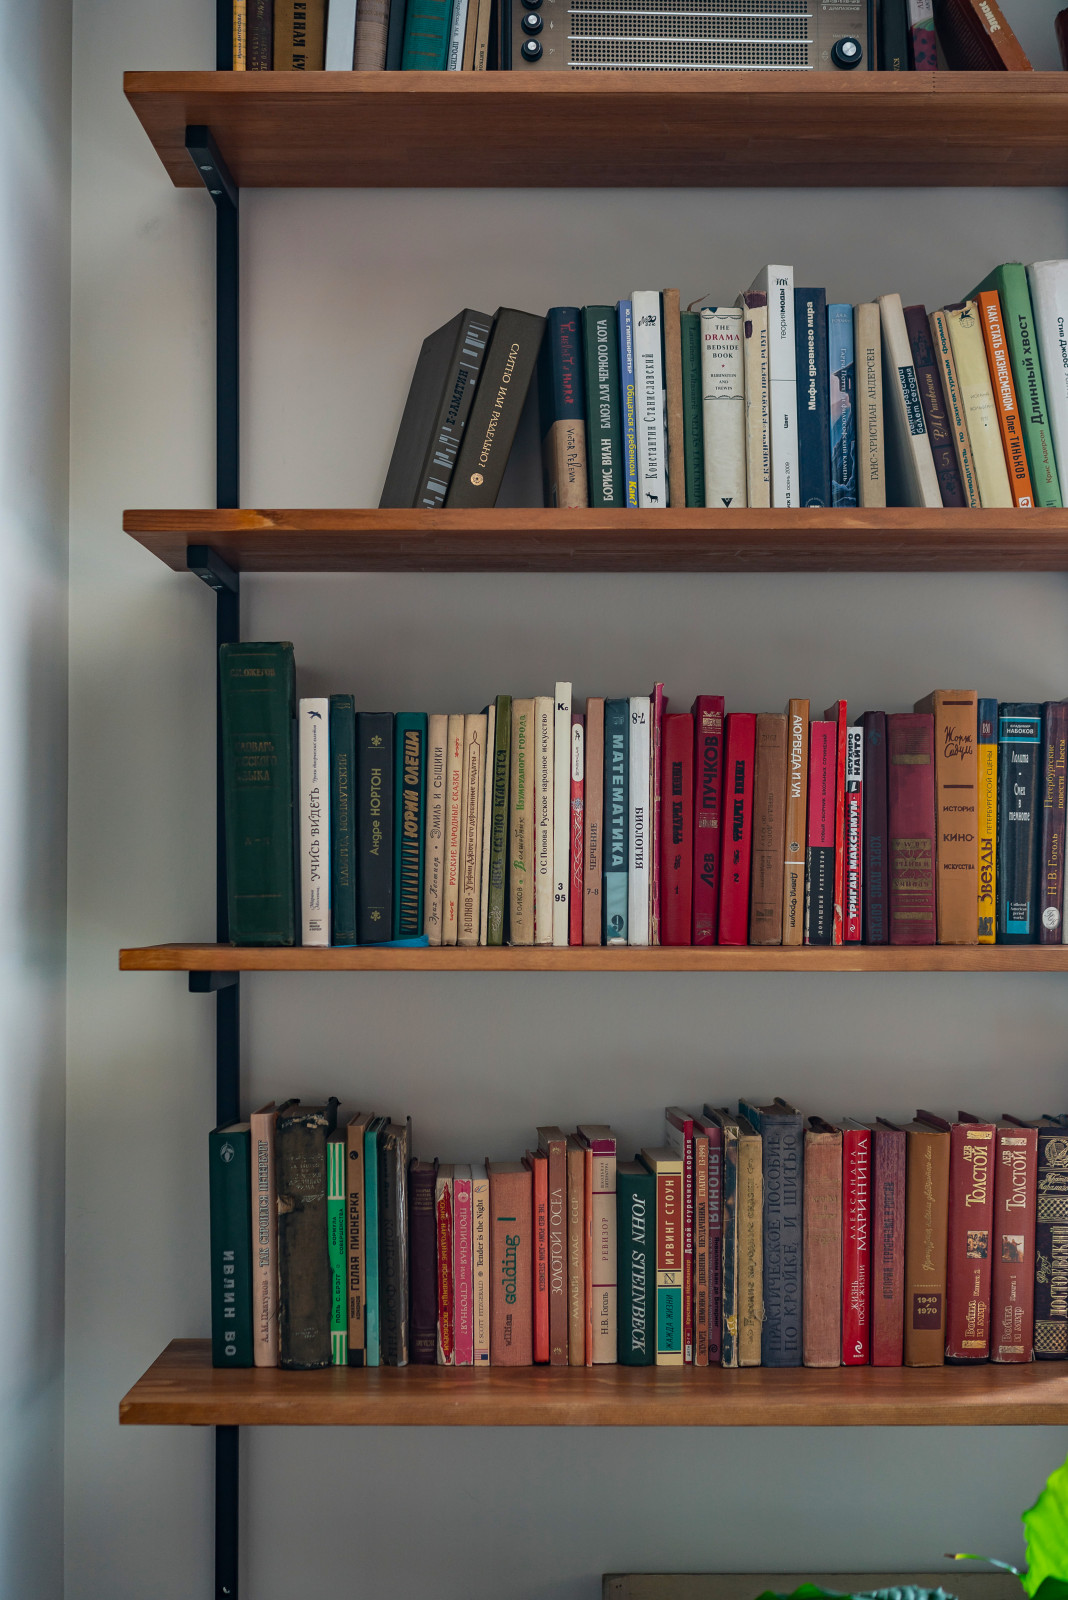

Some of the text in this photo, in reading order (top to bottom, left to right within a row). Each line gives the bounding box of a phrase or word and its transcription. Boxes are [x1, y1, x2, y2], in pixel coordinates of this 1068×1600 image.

[705, 333, 740, 341] DRAMA
[806, 302, 817, 410] Мифы древнего мира
[1057, 317, 1065, 338] Стив
[1058, 340, 1068, 368] Джобс
[597, 320, 610, 428] БЛЮЗ ДЛЯ ЧЕРНОГО КОТА
[987, 305, 1013, 411] КАК СТАТЬ БИЗНЕСМЕНОМ
[1017, 315, 1044, 425] Длинный хвост
[479, 343, 519, 467] СЛИТНО ИЛИ РАЗДЕЛЬНО?
[626, 385, 635, 424] Общаться
[642, 354, 656, 422] Станиславский
[866, 348, 878, 480] ГАНС-ХРИСТИАН АНДЕРСЕН
[936, 317, 977, 508] Путеводитель по архитектурным формам
[601, 439, 613, 501] БОРИС ВИАН
[627, 434, 637, 475] ребенком
[646, 426, 657, 479] Константин
[942, 452, 950, 467] 5
[1006, 415, 1025, 479] Олег ТИНЬКОВ
[1038, 430, 1052, 483] Крис Андерсон
[628, 481, 637, 505] Как?
[791, 715, 802, 770] АЮРВЕДА
[852, 733, 861, 776] НАЙТО
[1006, 727, 1034, 735] НАБОКОВ
[402, 732, 420, 838] ЮРИЙ ОЛЕША
[611, 734, 624, 866] МАТЕМАТИКА
[702, 736, 718, 809] ПУЧКОВ
[791, 782, 801, 797] УМ
[1044, 745, 1056, 808] Петербургские
[1056, 739, 1066, 809] повести Пьесы
[308, 787, 321, 882] УЧИСЬ ВИДЕТЬ
[370, 768, 382, 855] Андре НОРТОН
[449, 770, 459, 885] РУССКИЕ НАРОДНЫЕ СКАЗКИ
[634, 807, 645, 869] БИОЛОГИЯ
[944, 834, 975, 842] КИНО-
[978, 751, 994, 905] Звезды ПЕТЕРБУРГСКОЙ СЦЕНЫ
[589, 823, 598, 870] ЧЕРЧЕНИЕ
[700, 853, 715, 888] Лев
[849, 800, 858, 919] ТРИГАН МАКСИМУМ
[558, 883, 563, 891] 3
[734, 873, 740, 883] 2
[870, 836, 883, 940] ХОРХЕ ЛУИС БОРХЕС
[258, 1139, 270, 1267] ТАК СТРОИЛСЯ ПЕТЕРБУРГ
[476, 1199, 485, 1219] Night
[665, 1179, 675, 1215] СТОУН
[685, 1174, 693, 1223] огуречного
[856, 1138, 868, 1251] МАРИНИНА
[883, 1182, 894, 1209] РОССИИ
[349, 1192, 360, 1291] ГОЛАЯ ПИОНЕРКА
[476, 1221, 484, 1233] the
[476, 1242, 484, 1267] Tender
[549, 1188, 563, 1295] ЗОЛОТОЙ ОСЕЛ
[601, 1217, 609, 1261] РЕВИЗОР
[665, 1220, 675, 1265] ИРВИНГ
[685, 1227, 693, 1254] Долой
[697, 1145, 707, 1356] ЭДУАРД ЛИМОНОВ ДНЕВНИК НЕУДАЧНИКА ГЛАГОЛ 13-1991
[766, 1134, 781, 1351] ПРАКТИЧЕСКОЕ ПОСОБИЕ
[781, 1134, 798, 1350] ПО КРОЙКЕ И ШИТЬЮ
[883, 1218, 894, 1263] ТЕРРОРИЗМА
[571, 1197, 580, 1319] МАЛЫЙ АТЛАС СССР
[631, 1193, 646, 1355] JOHN STEINBECK
[883, 1267, 893, 1299] ИСТОРИЯ
[223, 1250, 237, 1356] ИВЛИН ВО
[502, 1235, 520, 1346] william Golding
[665, 1294, 674, 1320] ЖИЗНИ
[851, 1280, 859, 1311] ЖИЗНЬ
[858, 1264, 866, 1325] ПОСЛЕ ЖИЗНИ
[965, 1300, 977, 1337] Война
[665, 1322, 674, 1349] ЖАЖДА
[1002, 1305, 1013, 1342] Война
